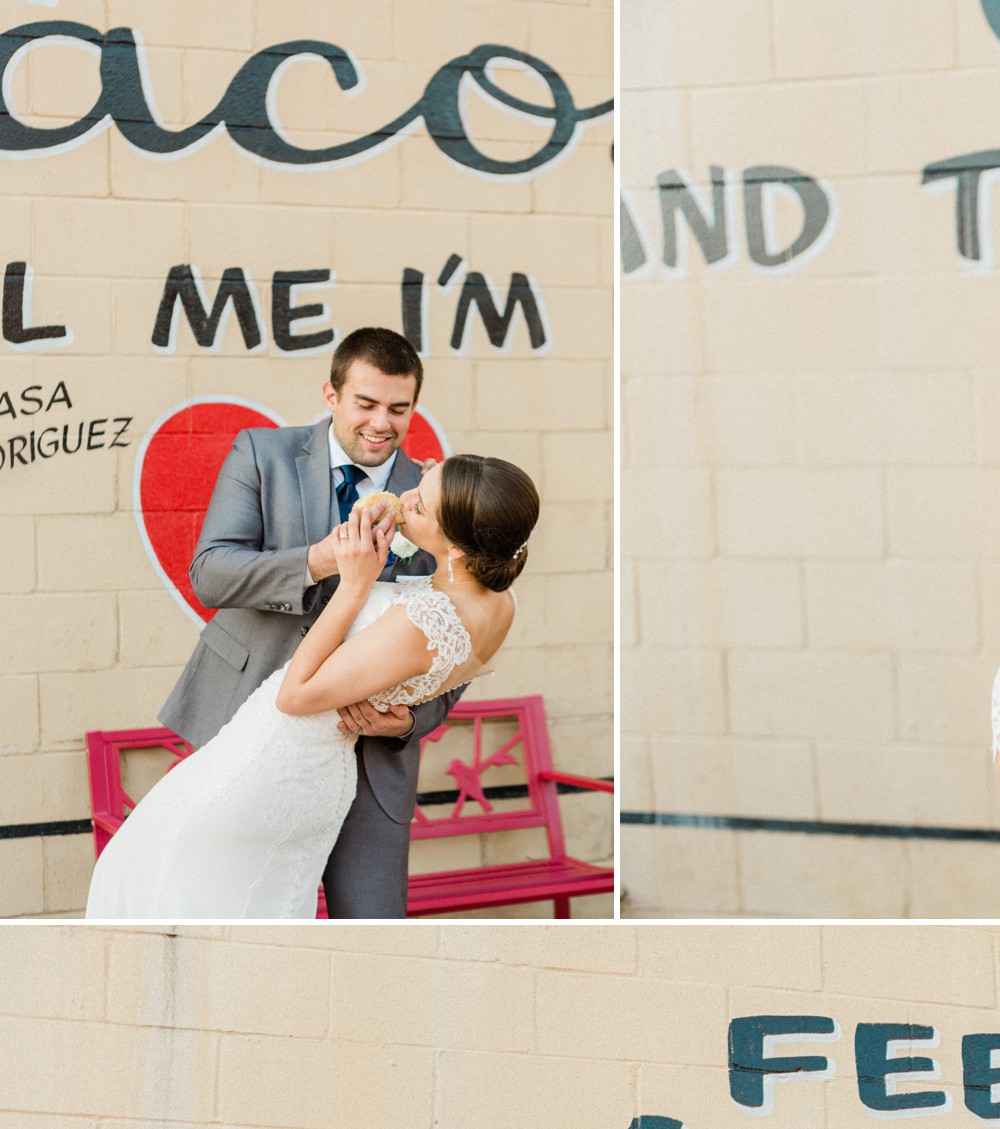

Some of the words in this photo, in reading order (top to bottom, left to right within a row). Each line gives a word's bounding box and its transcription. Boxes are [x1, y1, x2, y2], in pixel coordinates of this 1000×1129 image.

[0, 20, 614, 174] aco
[152, 264, 335, 350] ME
[402, 254, 546, 352] I'M
